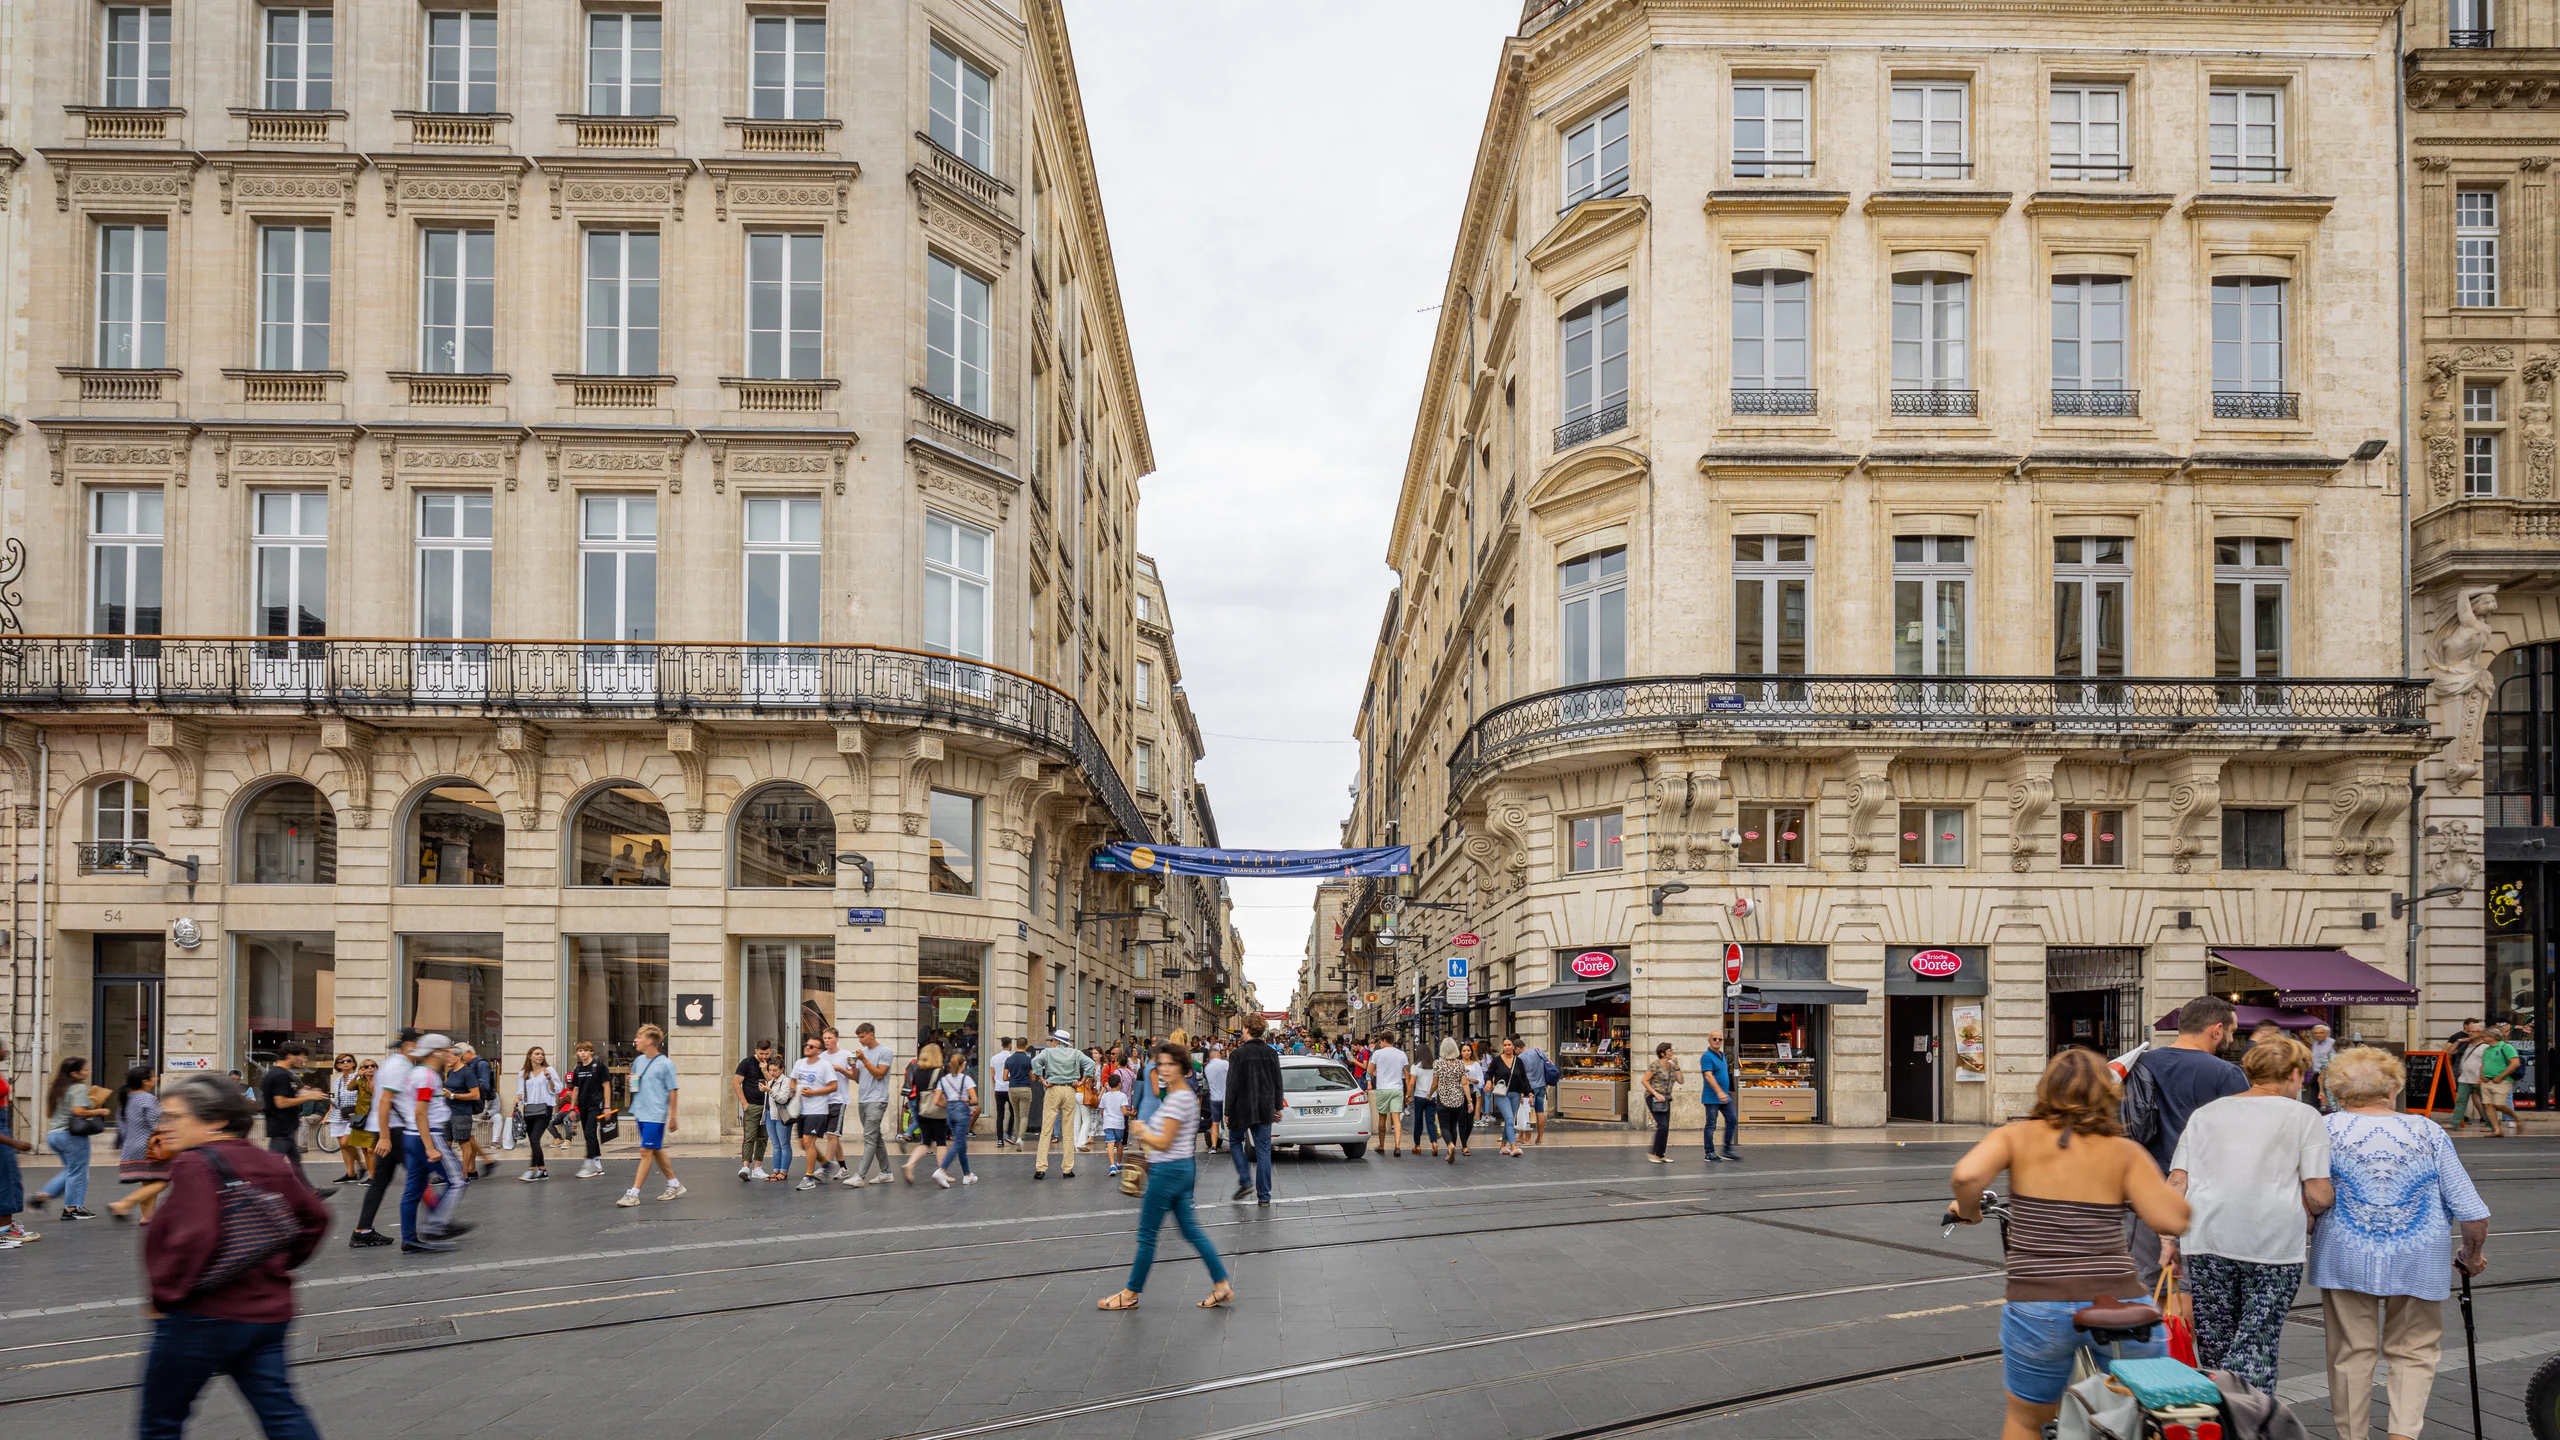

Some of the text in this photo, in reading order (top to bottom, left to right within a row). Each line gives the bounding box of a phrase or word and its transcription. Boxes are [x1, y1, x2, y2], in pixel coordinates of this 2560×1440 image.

[104, 910, 123, 922] 54
[1577, 960, 1609, 972] Dorée
[1918, 958, 1956, 970] Dorée
[2322, 992, 2347, 1003] Ernest
[2356, 995, 2379, 1004] glacier
